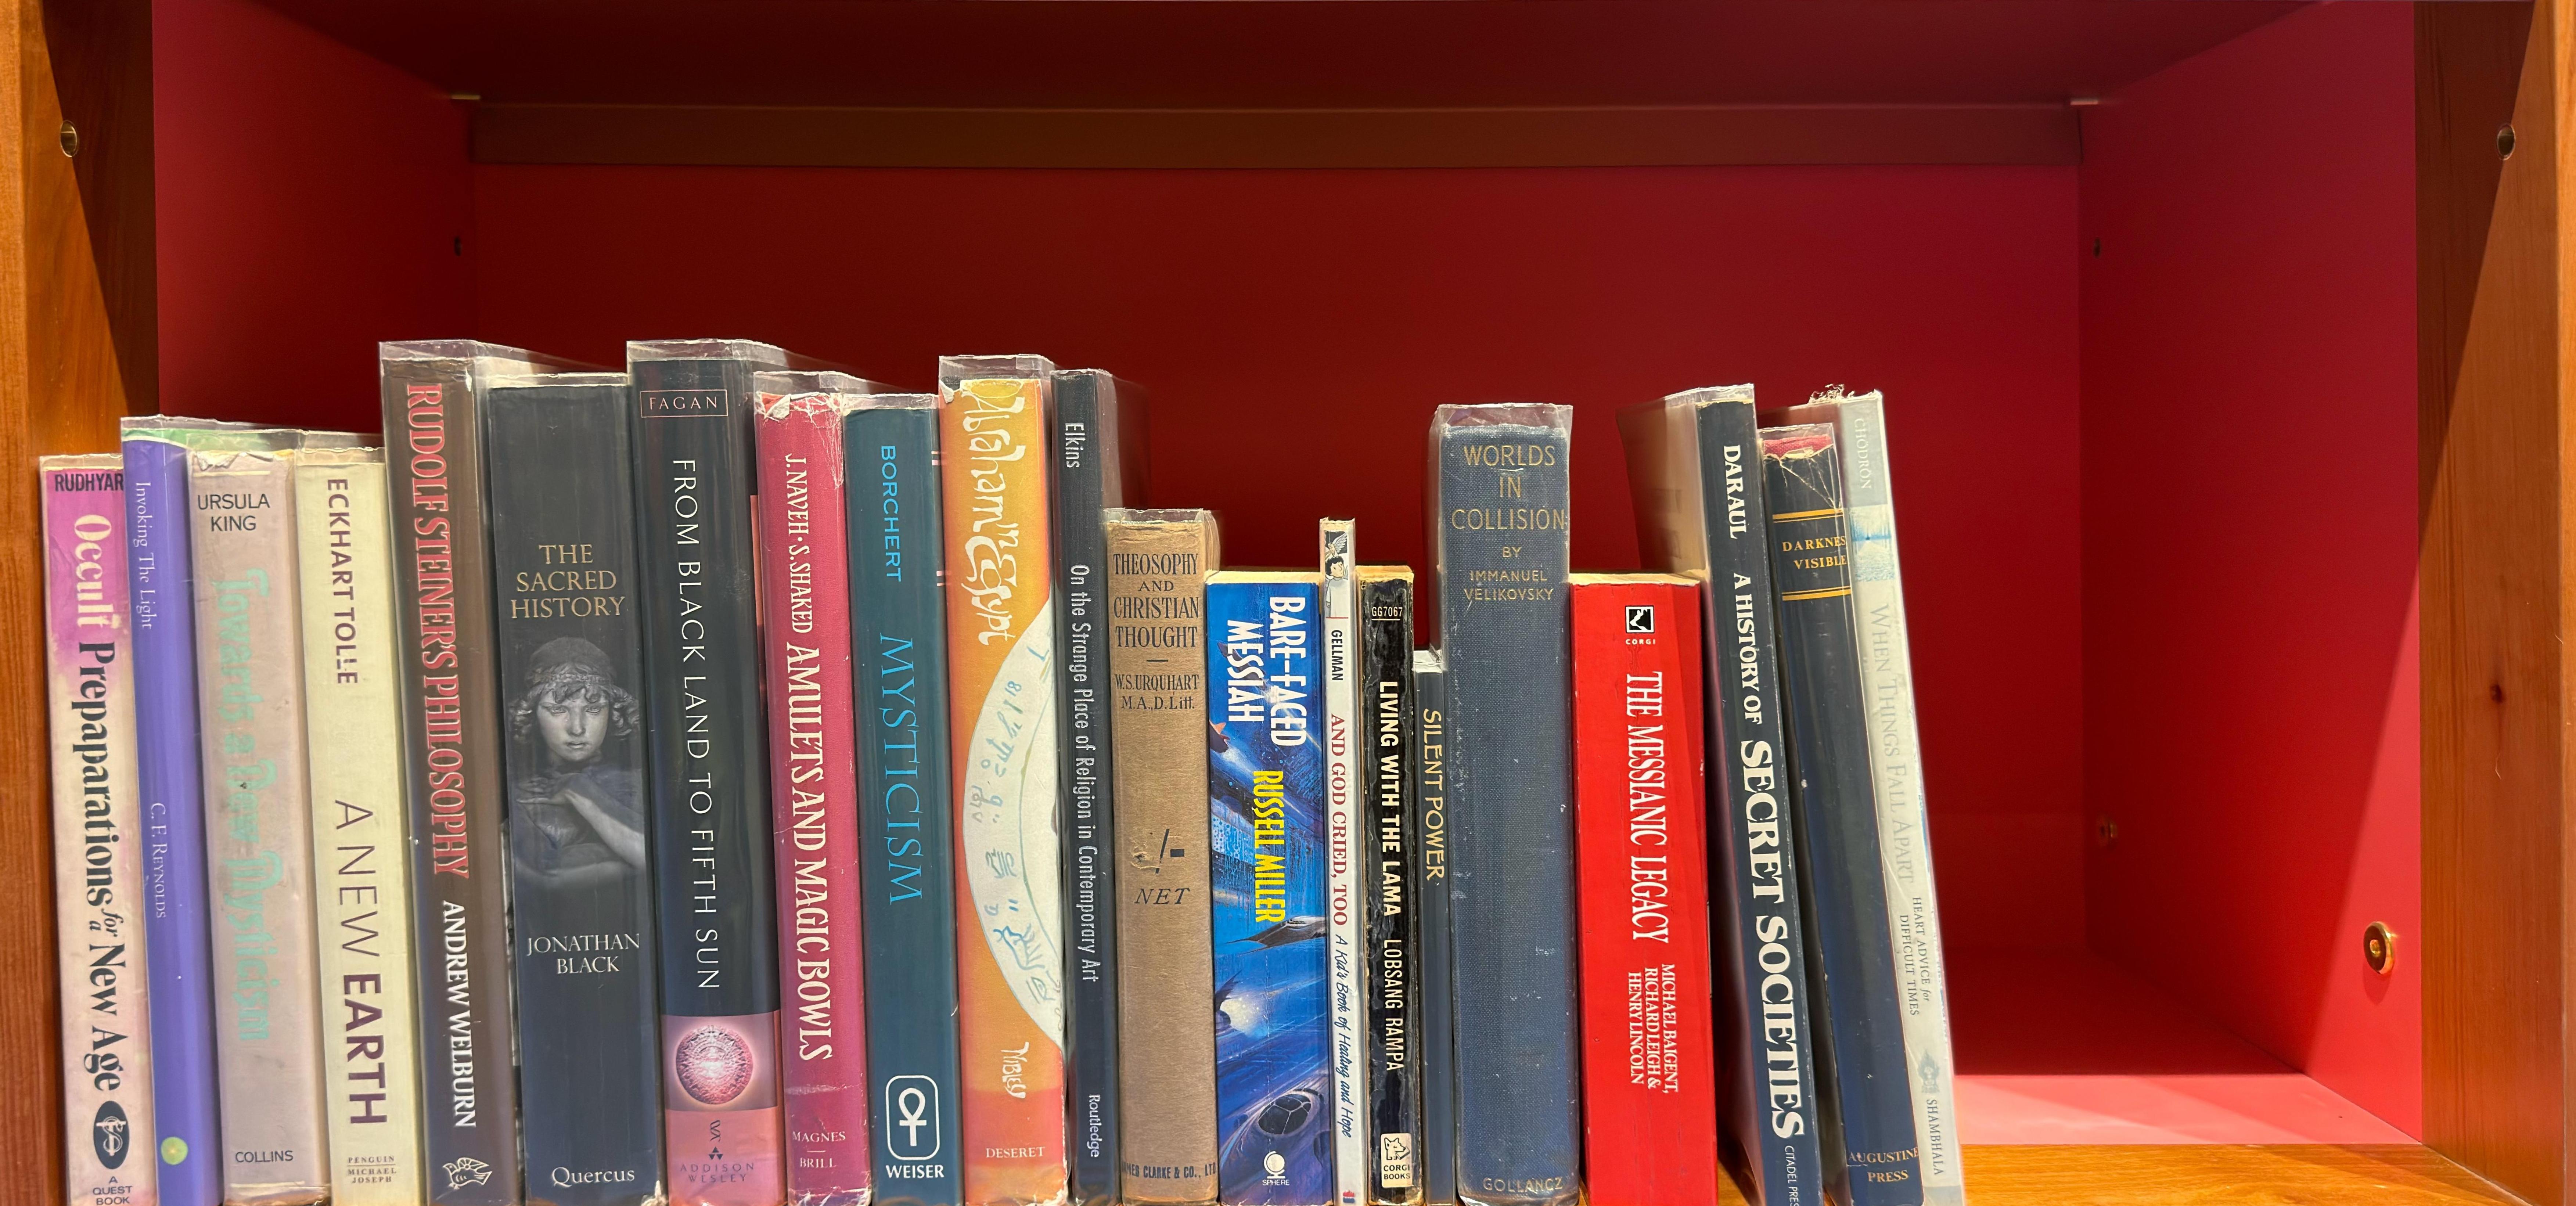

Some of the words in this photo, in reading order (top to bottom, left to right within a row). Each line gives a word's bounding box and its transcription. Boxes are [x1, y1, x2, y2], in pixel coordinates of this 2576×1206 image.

[649, 396, 718, 410] FAGAN
[407, 382, 449, 512] RUDOLF
[960, 389, 1026, 534] Abraham
[1064, 422, 1086, 469] Elkins
[1463, 444, 1555, 467] WORLDS
[1854, 417, 1872, 490] CHÖDRÖN
[55, 473, 123, 492] RUDHYAR
[197, 493, 271, 510] URSULA
[672, 459, 700, 545] FROM
[1499, 476, 1522, 498] IN
[1723, 444, 1747, 540] DARAUL
[133, 482, 151, 547] Invoking
[211, 515, 257, 532] KING
[881, 445, 902, 583] BORCHERT
[1451, 508, 1565, 530] COLLISION
[327, 479, 355, 601] ECKHART
[538, 544, 593, 565] THE
[1502, 546, 1522, 558] BY
[1782, 535, 1846, 552] DARKNES
[75, 514, 118, 629] Occult
[138, 552, 155, 583] The
[516, 570, 617, 592] SACRED
[1070, 564, 1090, 586] On
[1113, 553, 1199, 575] THEOSOPHY
[1469, 570, 1547, 582] IMMANUEL
[1733, 573, 1751, 590] A
[1793, 555, 1847, 569] VISIBLE
[511, 596, 626, 619] HISTORY
[961, 535, 1019, 646] Egypt
[1071, 593, 1092, 617] the
[1113, 596, 1199, 619] CHRISTIAN
[1137, 580, 1174, 592] AND
[1464, 588, 1554, 601] VELIKOVSKY
[136, 590, 157, 629] Light
[678, 561, 706, 663] BLACK
[1371, 606, 1403, 618] GG7067
[211, 568, 270, 722] Towards
[334, 606, 359, 684] TOLLE
[1068, 622, 1092, 681] Strange
[1115, 626, 1198, 648] THOUGHT
[1331, 629, 1343, 681] GELLMAN
[1734, 593, 1760, 692] HISTORY
[1870, 603, 1891, 673] WHEN
[1227, 620, 1264, 722] MESSIAH
[1269, 596, 1307, 746] BARE-FACED
[786, 641, 824, 783] AMULETS
[1073, 688, 1094, 729] Place
[1379, 681, 1399, 747] LIVING
[1626, 671, 1663, 717] THE
[1743, 695, 1763, 725] OF
[684, 676, 710, 759] LAND
[1331, 713, 1345, 756] AND
[1878, 678, 1900, 757] THINGS
[223, 734, 255, 754] a
[1075, 735, 1096, 752] of
[1423, 708, 1443, 791] SILENT
[71, 641, 119, 907] Prepaparations
[423, 674, 469, 879] PHILOSOPHY
[879, 632, 923, 906] MYSTICISM
[1072, 757, 1097, 819] Religion
[1331, 762, 1346, 805] GOD
[1381, 754, 1400, 806] WITH
[1627, 724, 1667, 846] MESSIANIC
[1887, 763, 1907, 813] FALL
[150, 802, 166, 819] C.
[226, 758, 278, 843] New
[688, 771, 713, 814] TO
[1253, 770, 1285, 849] RUSSELL
[151, 824, 168, 839] F.
[335, 799, 374, 830] A
[790, 785, 827, 852] AND
[1077, 824, 1097, 839] in
[1382, 814, 1400, 853] THE
[1740, 739, 1785, 904] SECRET
[1330, 811, 1347, 878] CRIED,
[1425, 796, 1445, 881] POWER
[1892, 820, 1914, 883] APART
[691, 829, 717, 914] FIFTH
[1255, 854, 1286, 922] MILLER
[1382, 861, 1401, 916] LAMA
[337, 845, 381, 957] NEW
[794, 856, 831, 954] MAGIC
[1075, 845, 1098, 953] Contemporary
[1134, 887, 1190, 905] NET
[1332, 883, 1348, 926] TOO
[1630, 855, 1669, 945] LEGACY
[1912, 896, 1925, 935] HEART
[89, 920, 101, 931] a
[100, 907, 125, 937] for
[1335, 934, 1348, 946] A
[222, 849, 284, 1041] Mysticism
[442, 900, 470, 1005] ANDREW
[526, 933, 640, 956] JONATHAN
[556, 956, 620, 975] BLACK
[695, 928, 720, 988] SUN
[1335, 950, 1348, 980] Kid's
[1899, 914, 1915, 976] DIFFICULT
[1907, 979, 1919, 1016] TIMES
[1917, 940, 1931, 985] ADVICE
[89, 943, 126, 1016] New
[1081, 959, 1101, 983] Art
[1384, 939, 1403, 1009] LOBSANG
[796, 958, 833, 1062] BOWLS
[1336, 980, 1350, 1012] Book
[1628, 972, 1643, 1020] HENRY
[1644, 967, 1660, 1033] RICHARD
[1661, 964, 1677, 1029] MICHAEL
[1920, 989, 1930, 1002] for
[1334, 1015, 1350, 1032] of
[1385, 1017, 1404, 1072] RAMPA
[1755, 915, 1806, 1140] SOCIETIES
[83, 1025, 129, 1091] Age
[343, 973, 388, 1124] EARTH
[447, 1011, 477, 1128] WELBURN
[1335, 1033, 1353, 1079] Healing
[1629, 1022, 1645, 1085] LINCOLN
[1646, 1034, 1661, 1076] LEIGH
[1662, 1029, 1679, 1094] BAIGENT,
[1340, 1080, 1354, 1104] and
[1647, 1077, 1661, 1090] &
[792, 1130, 846, 1144] MAGNES
[1086, 1093, 1102, 1158] Routledge
[1336, 1104, 1354, 1138] Hope
[1926, 1099, 1944, 1176] SHAMBHALA
[235, 1150, 294, 1163] COLLINS
[347, 1167, 397, 1176] MICHAEL
[348, 1155, 395, 1164] PENGUIN
[680, 1162, 755, 1172] ADDISON
[799, 1156, 837, 1169] BRILL
[885, 1164, 945, 1178] WEISER
[986, 1146, 1045, 1158] DESERET
[1143, 1165, 1171, 1179] CLARKE
[1174, 1166, 1180, 1178] &
[1784, 1145, 1798, 1185] CITADEL
[1848, 1146, 1919, 1164] AUGUSTINE
[92, 1186, 133, 1195] QUEST
[352, 1176, 393, 1184] JOSEPH
[551, 1166, 635, 1188] Quercus
[688, 1174, 747, 1183] WESLEY
[1483, 1177, 1564, 1194] GOLLANCZ
[1788, 1186, 1800, 1206] PRES
[1867, 1169, 1909, 1182] PRESS
[96, 1196, 130, 1206] BOOK
